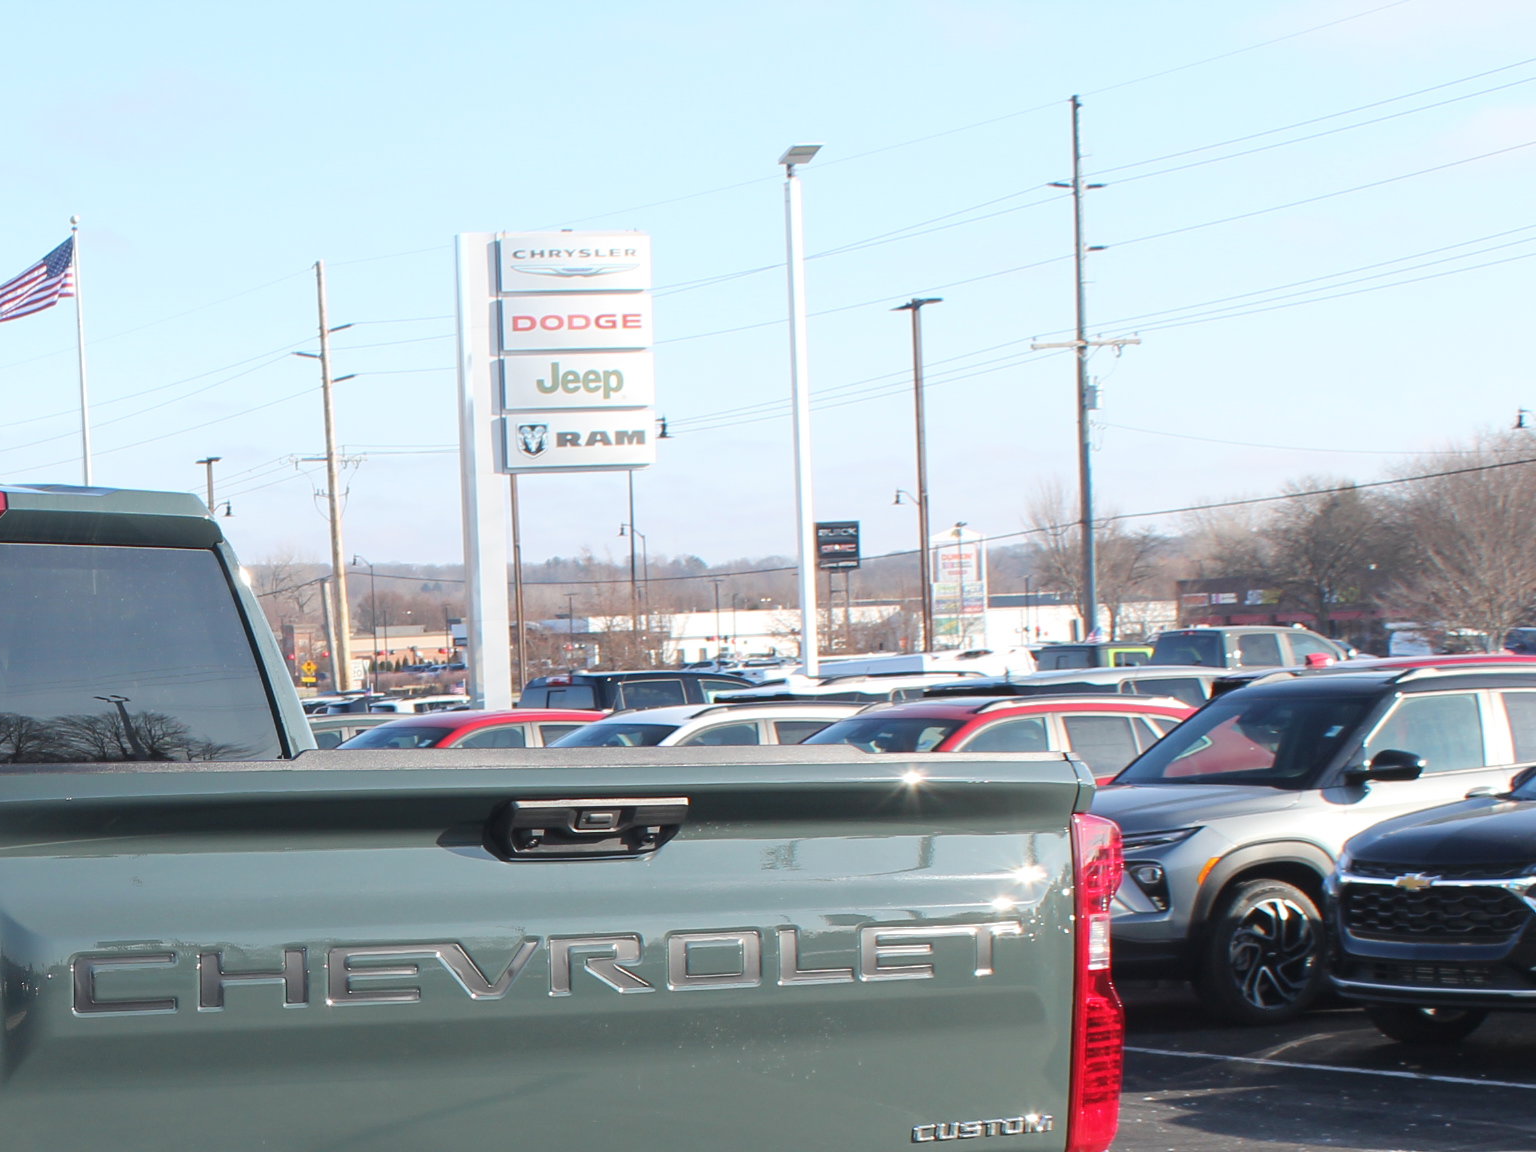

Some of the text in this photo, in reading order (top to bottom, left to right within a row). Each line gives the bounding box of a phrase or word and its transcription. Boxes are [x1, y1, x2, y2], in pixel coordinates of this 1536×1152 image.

[512, 248, 637, 259] CHRYSLER
[511, 313, 642, 332] DODGE
[536, 361, 624, 400] Jeep
[556, 429, 646, 448] RAM
[817, 527, 857, 537] BUICK
[70, 920, 1024, 1015] CHEVROLET
[912, 1114, 1055, 1143] CUSTOM
